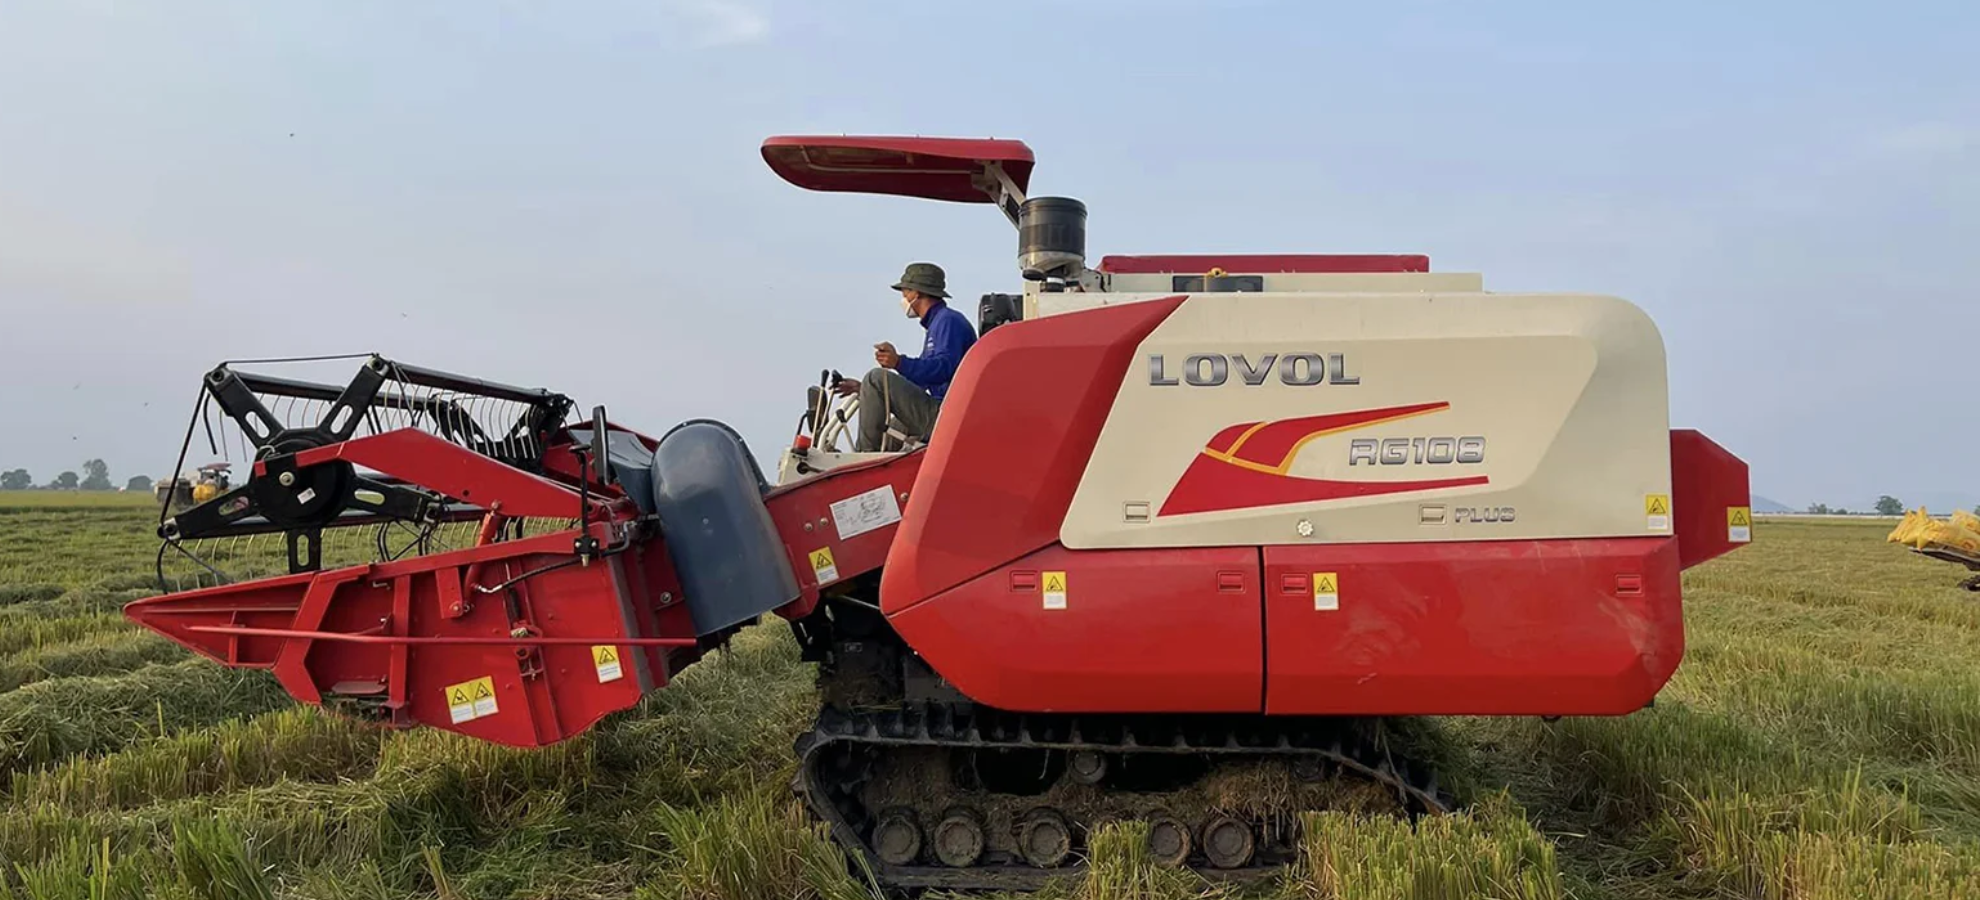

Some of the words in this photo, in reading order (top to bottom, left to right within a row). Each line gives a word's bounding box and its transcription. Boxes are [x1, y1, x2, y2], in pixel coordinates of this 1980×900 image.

[1149, 353, 1360, 386] LOVOL
[1349, 437, 1486, 465] RG108
[1455, 507, 1515, 523] PLUS
